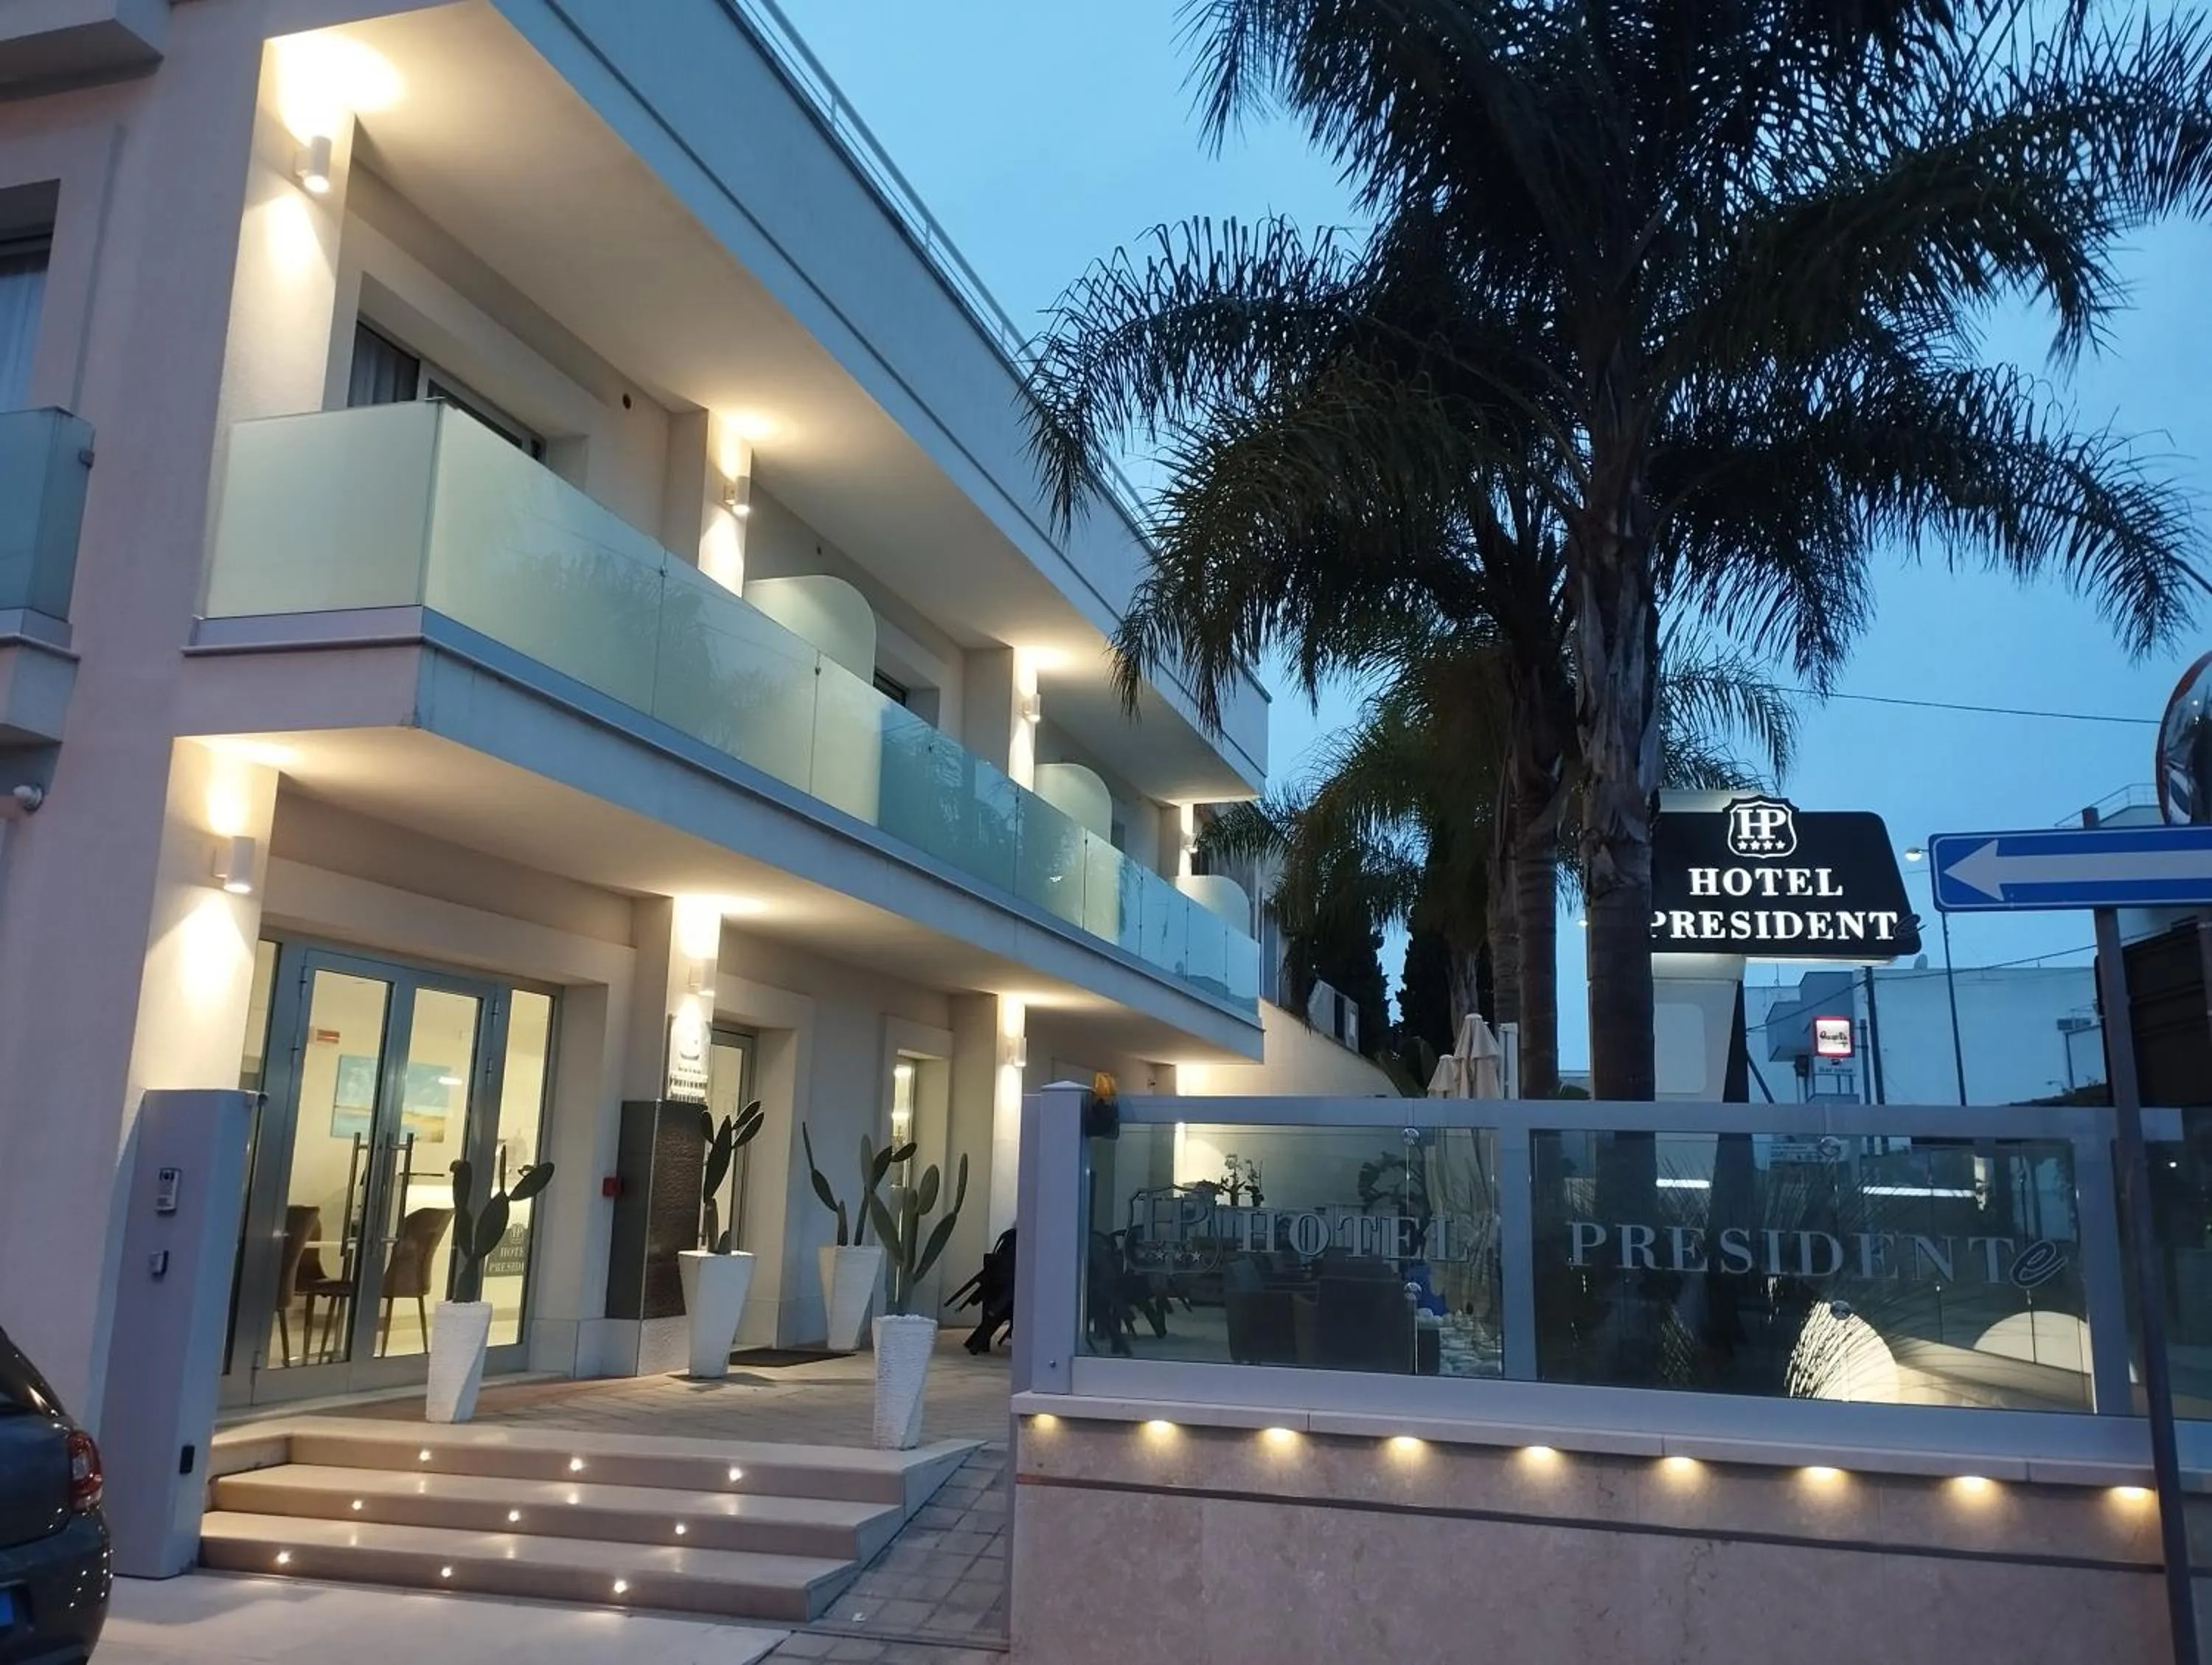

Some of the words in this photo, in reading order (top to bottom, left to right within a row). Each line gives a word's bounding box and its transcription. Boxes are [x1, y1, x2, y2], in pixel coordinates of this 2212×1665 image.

[1736, 808, 1787, 839] HP
[1688, 867, 1843, 897] HOTEL
[1651, 910, 1897, 941] PRESIDENT
[1237, 1209, 1470, 1263] HOTEL
[1566, 1220, 2015, 1285] PRESIDENT
